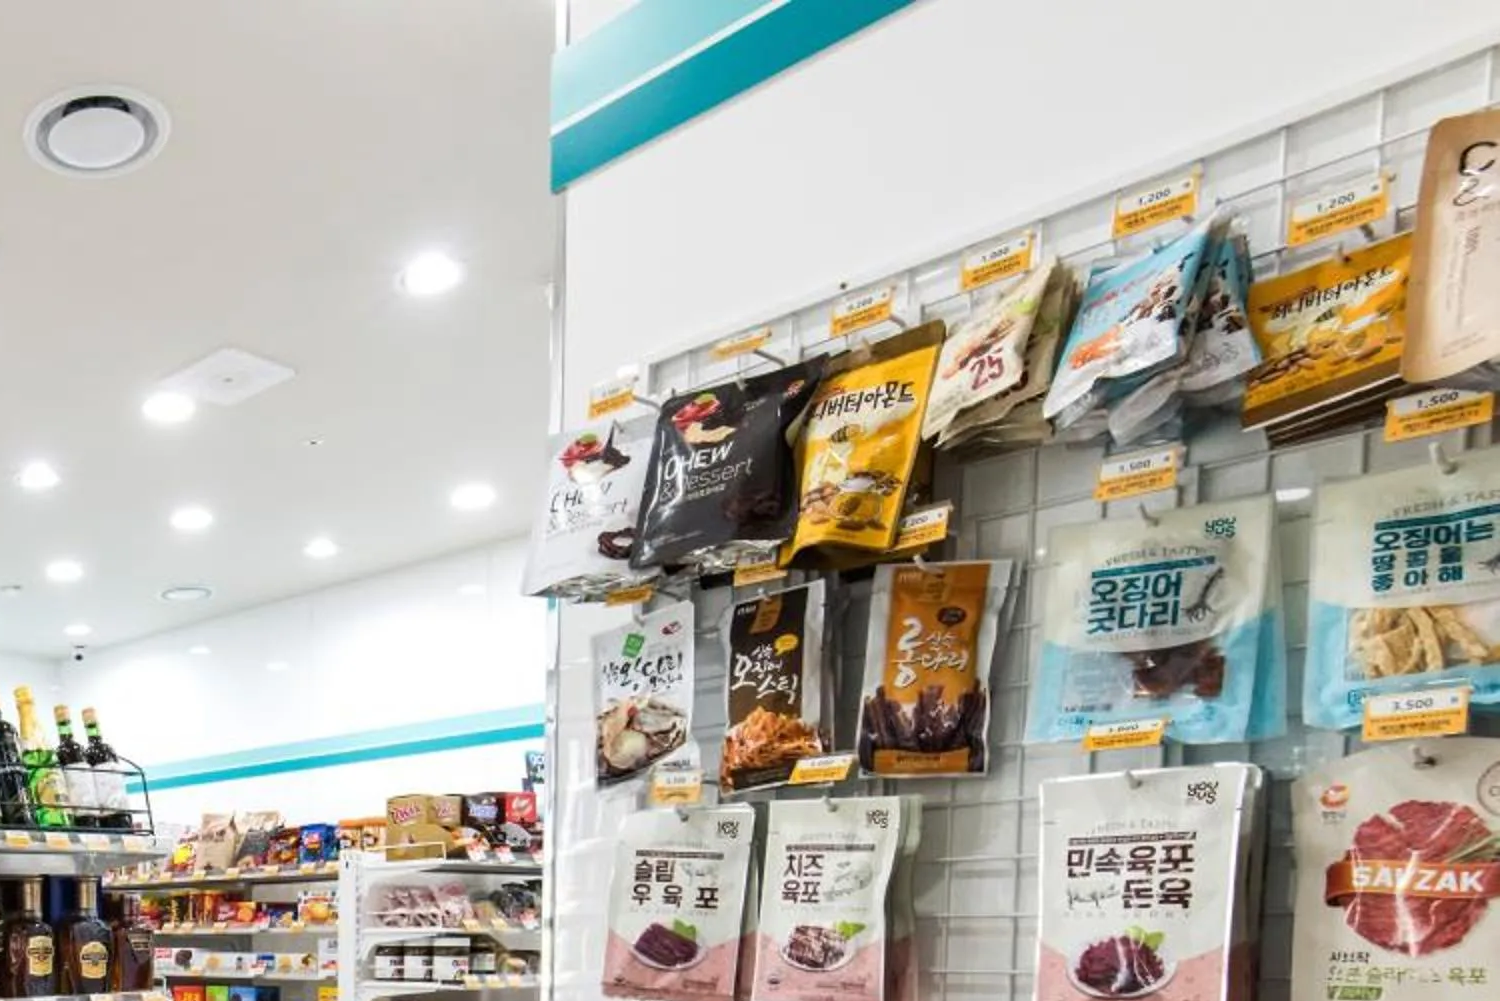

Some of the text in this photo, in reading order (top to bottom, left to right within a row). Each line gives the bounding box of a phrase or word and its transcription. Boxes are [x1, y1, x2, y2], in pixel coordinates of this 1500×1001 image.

[1372, 519, 1494, 553] 오징어는
[1088, 570, 1183, 605] 오징어
[634, 858, 675, 883] 슬림
[784, 854, 825, 878] 치즈
[1067, 843, 1195, 878] 민속육포
[781, 880, 821, 905] 육포
[1122, 877, 1194, 909] 돈육
